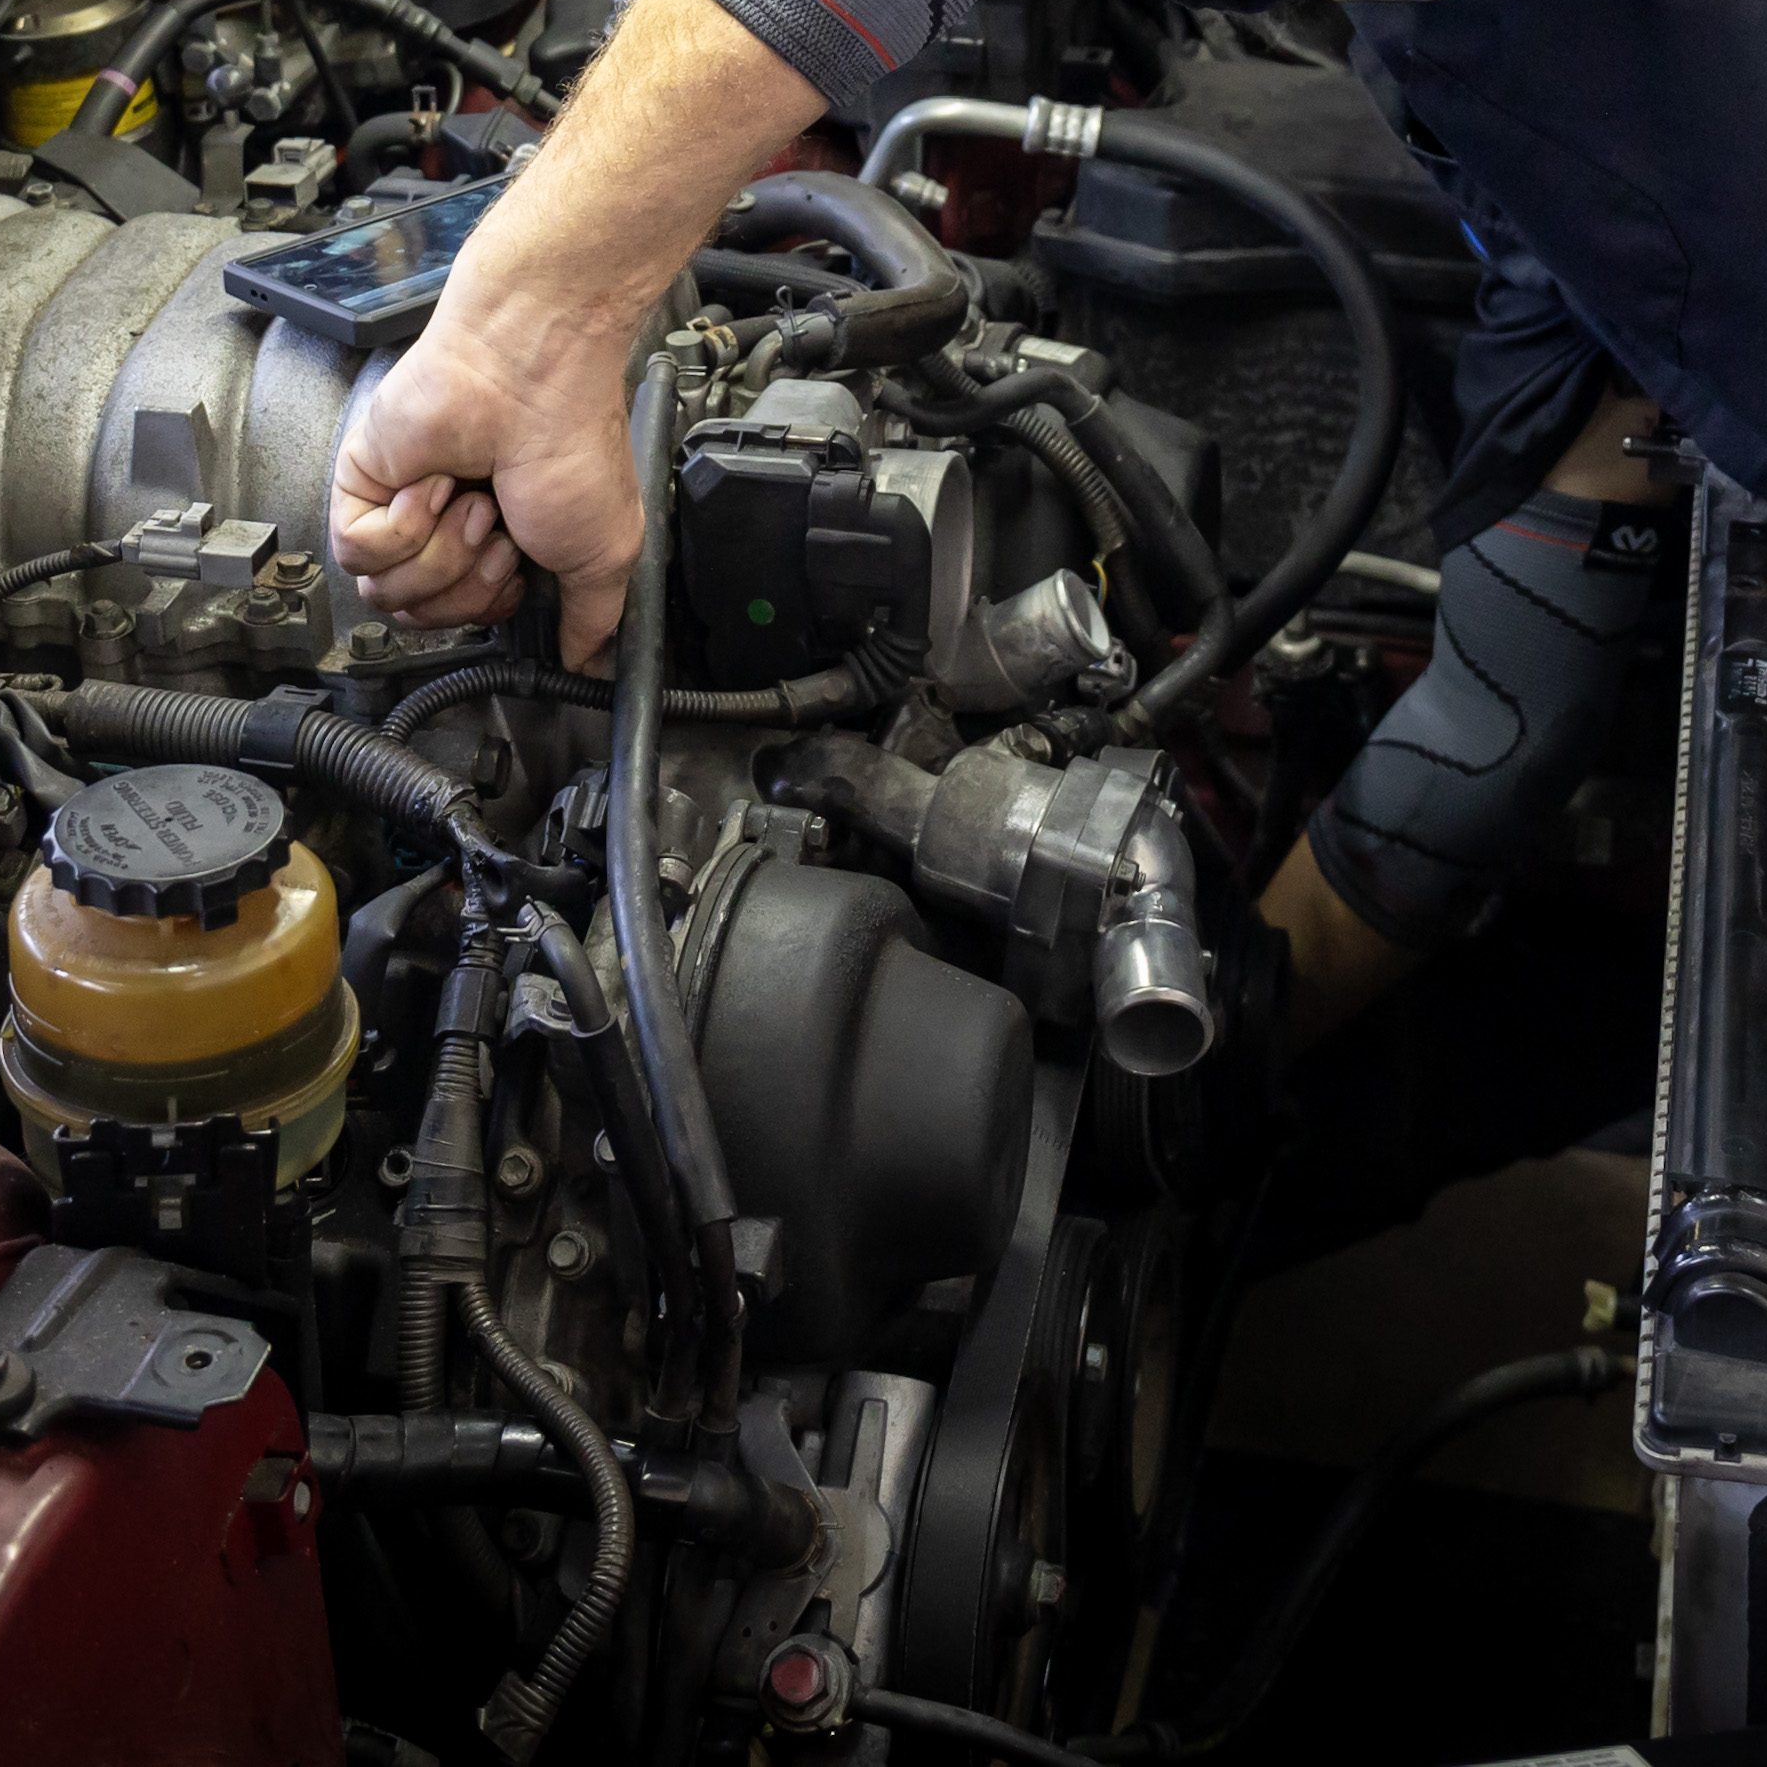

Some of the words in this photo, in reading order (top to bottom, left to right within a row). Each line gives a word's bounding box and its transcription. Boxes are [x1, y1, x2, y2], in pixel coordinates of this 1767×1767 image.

[112, 781, 167, 830] STEERING
[165, 800, 204, 832] FLUID
[202, 789, 238, 817] CLOSE
[100, 824, 129, 847] OPEN
